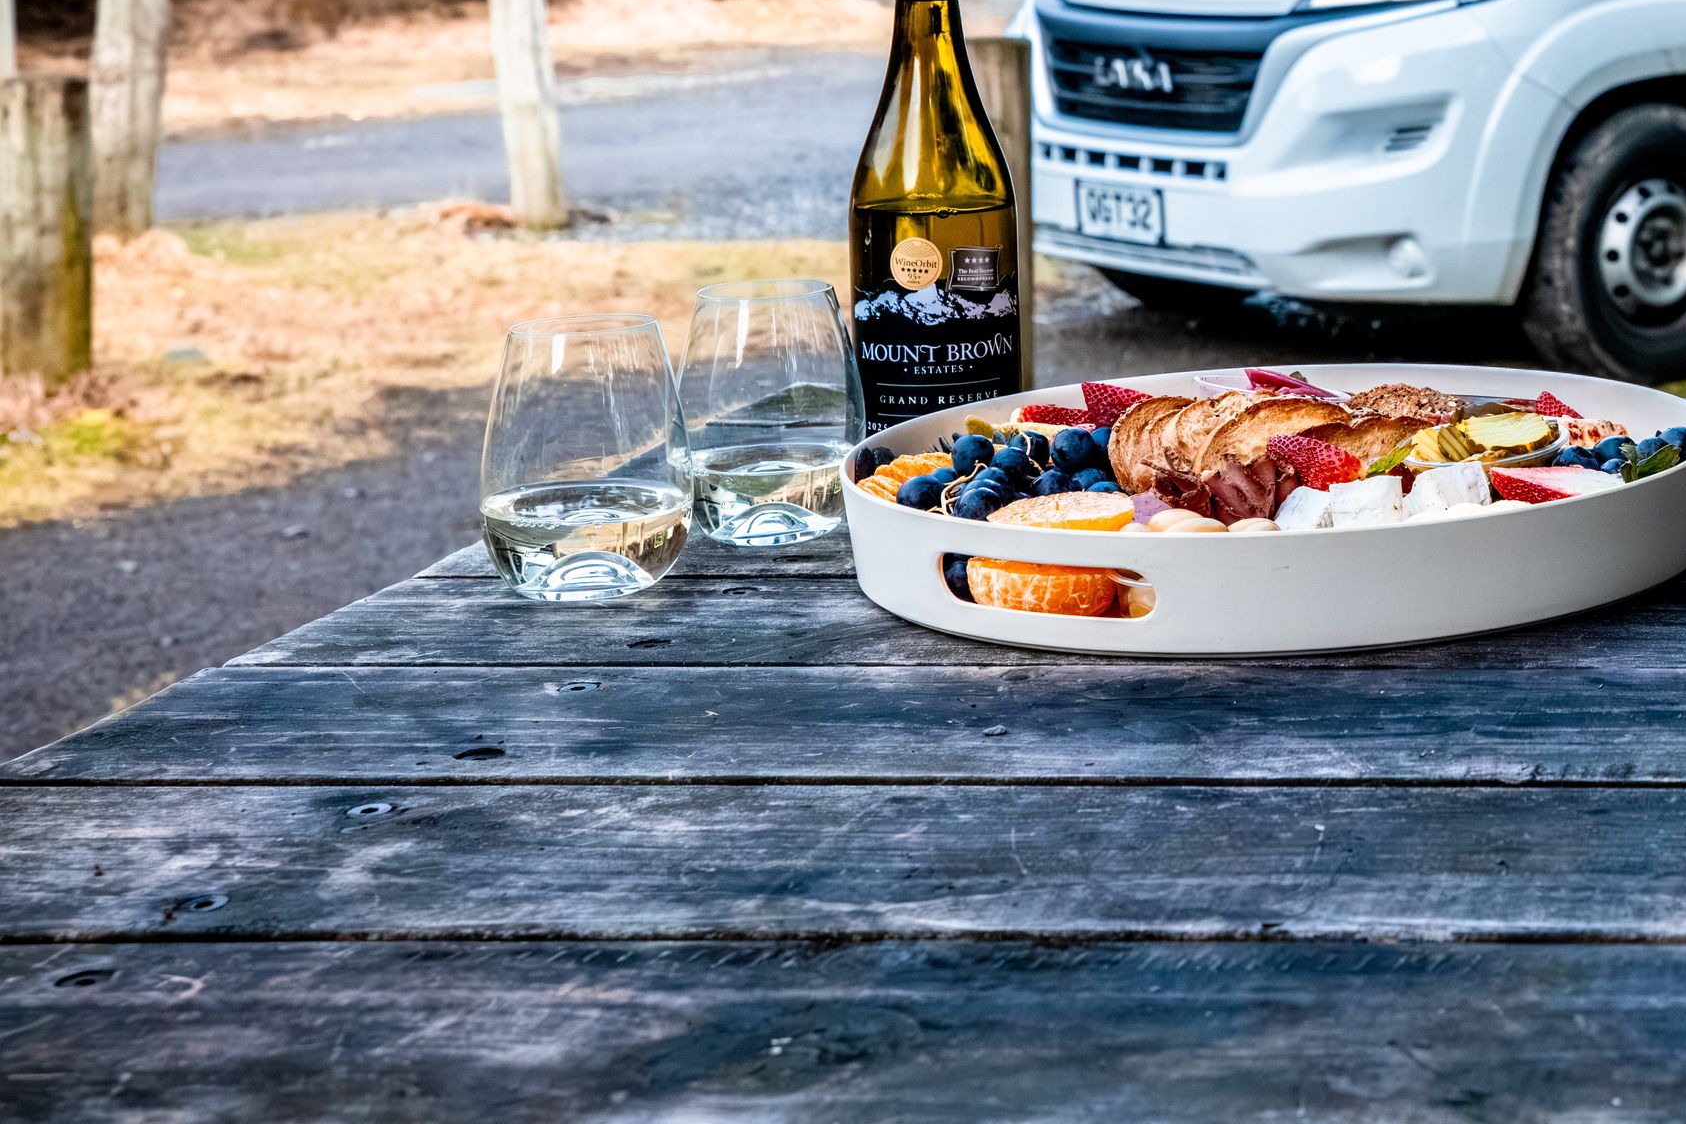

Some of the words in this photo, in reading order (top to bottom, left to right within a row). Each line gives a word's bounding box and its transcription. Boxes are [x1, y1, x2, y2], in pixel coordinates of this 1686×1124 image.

[895, 257, 937, 268] WineOrbit
[861, 341, 941, 363] MOUNT
[946, 332, 1013, 362] BROWN
[914, 364, 964, 375] ESTATES
[879, 394, 928, 405] GRAND
[938, 389, 998, 405] RESERVE
